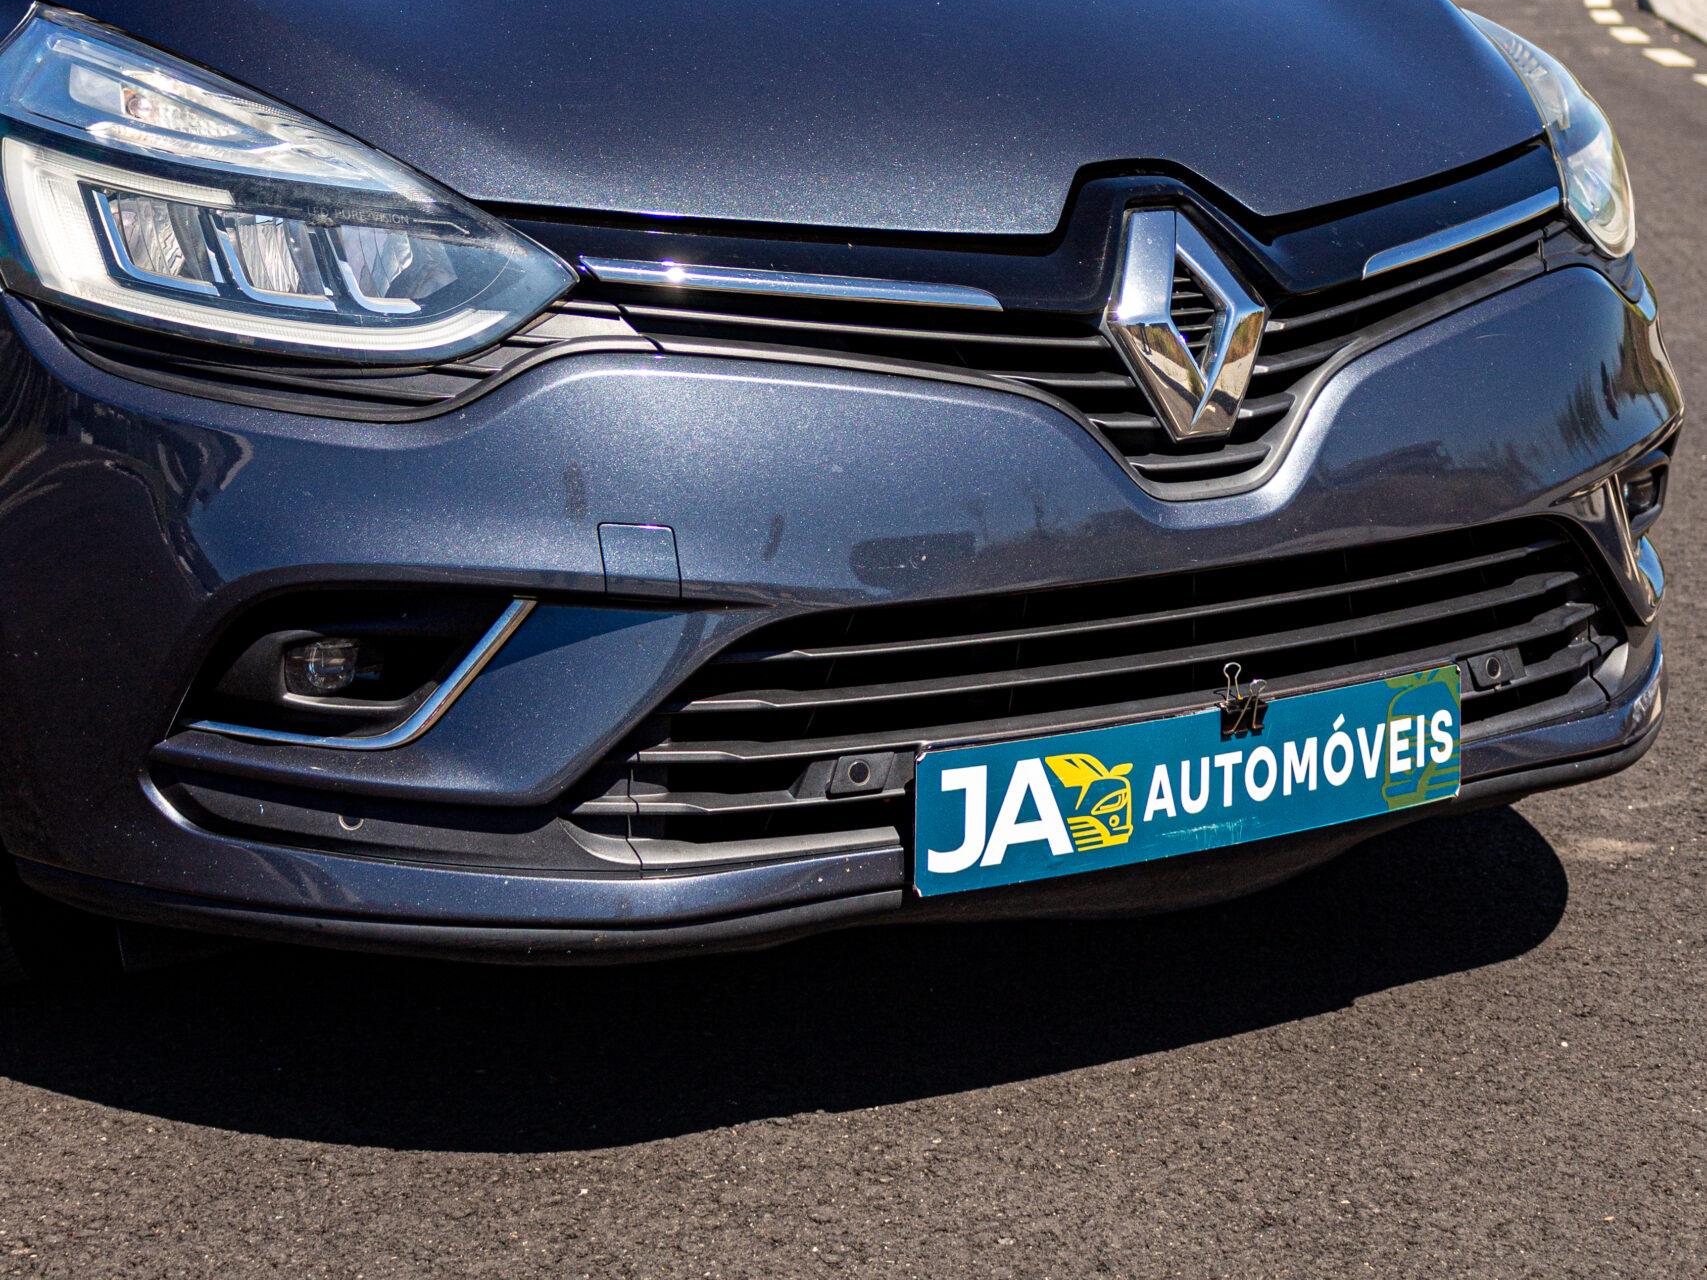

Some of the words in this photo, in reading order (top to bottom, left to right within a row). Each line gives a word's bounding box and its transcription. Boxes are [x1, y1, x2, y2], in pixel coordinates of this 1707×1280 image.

[335, 208, 367, 221] PURE
[370, 211, 410, 225] VISION
[927, 756, 1075, 874] JA
[1143, 709, 1454, 822] AUTOMÓVEIS
